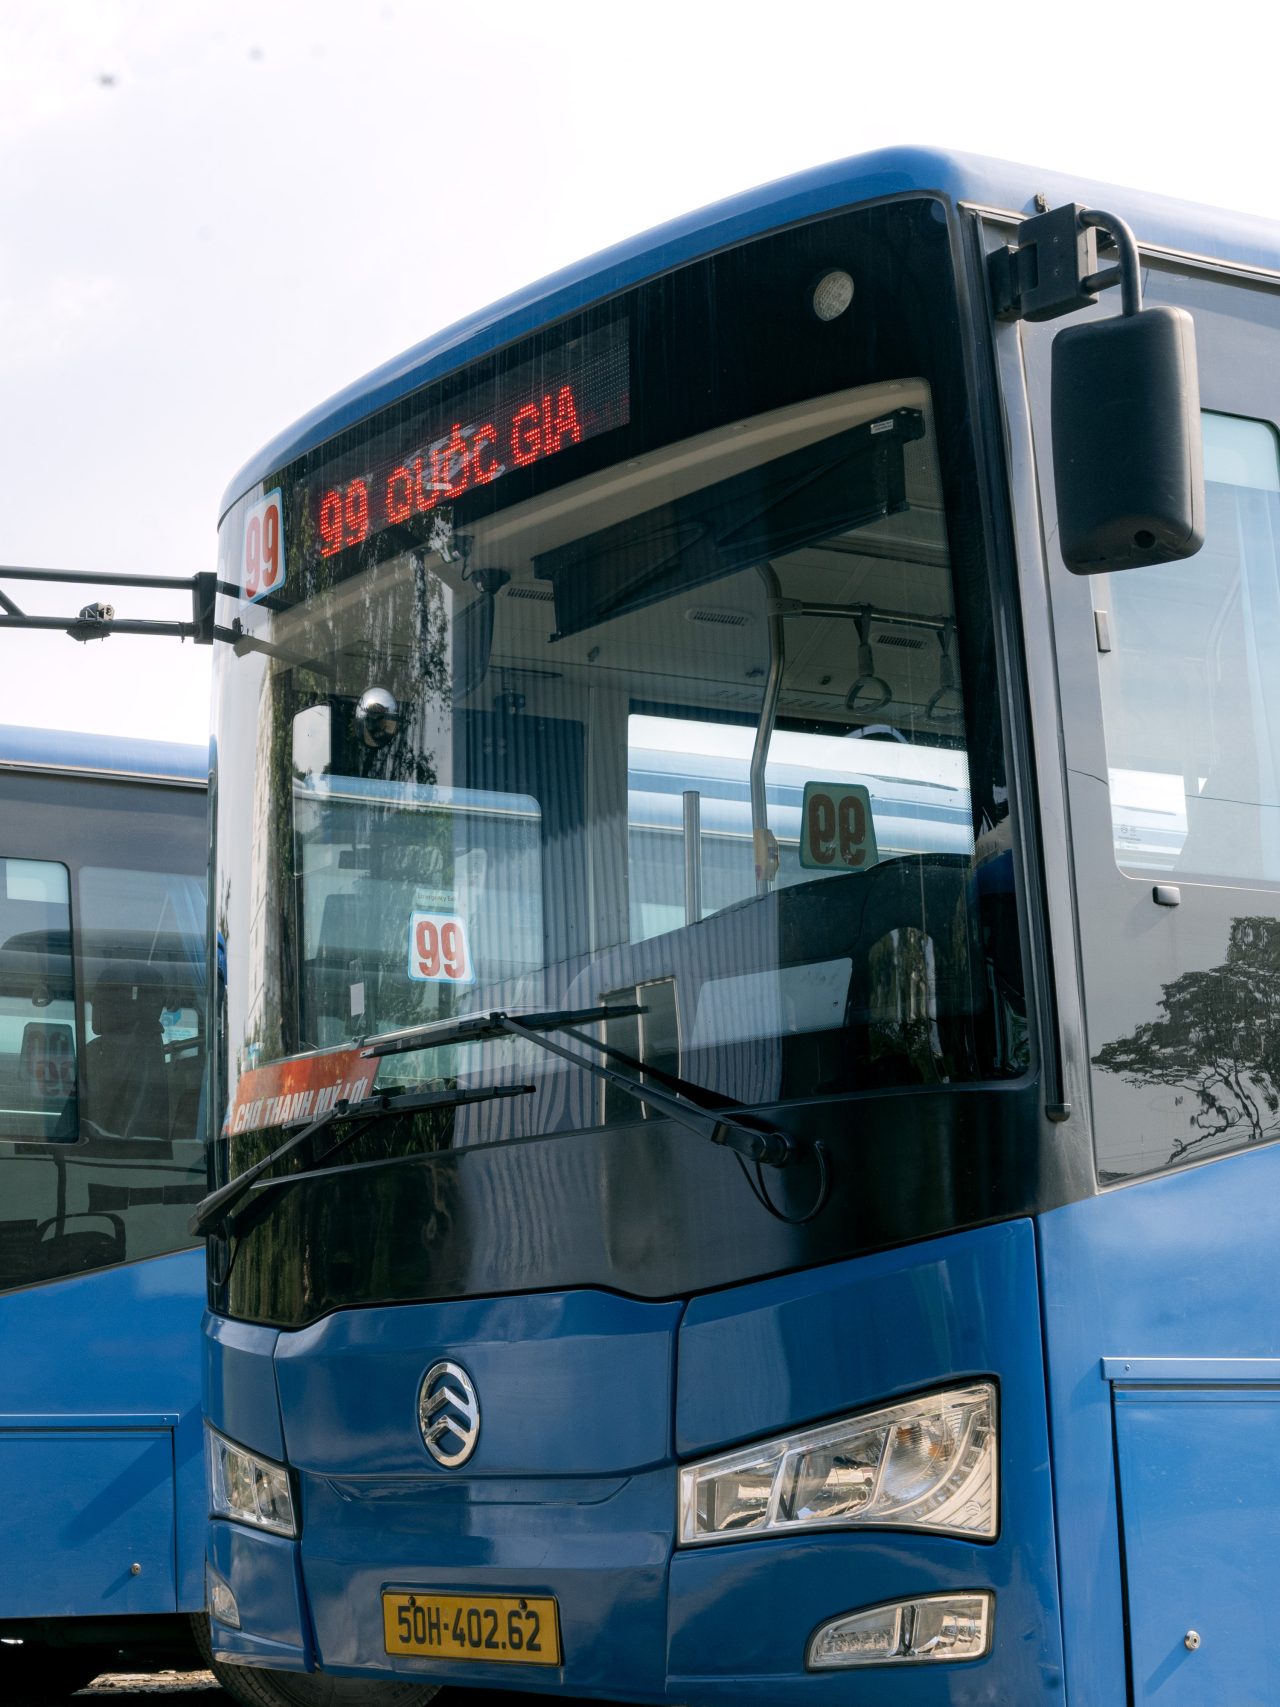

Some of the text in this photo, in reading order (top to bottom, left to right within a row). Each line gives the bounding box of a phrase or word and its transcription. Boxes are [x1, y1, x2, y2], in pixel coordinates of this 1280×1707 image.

[320, 479, 368, 558] 99
[511, 385, 580, 466] GIA
[246, 504, 279, 598] 99
[416, 920, 465, 979] 99
[264, 1089, 314, 1127] THANH
[397, 1605, 542, 1651] 50H-402.62
